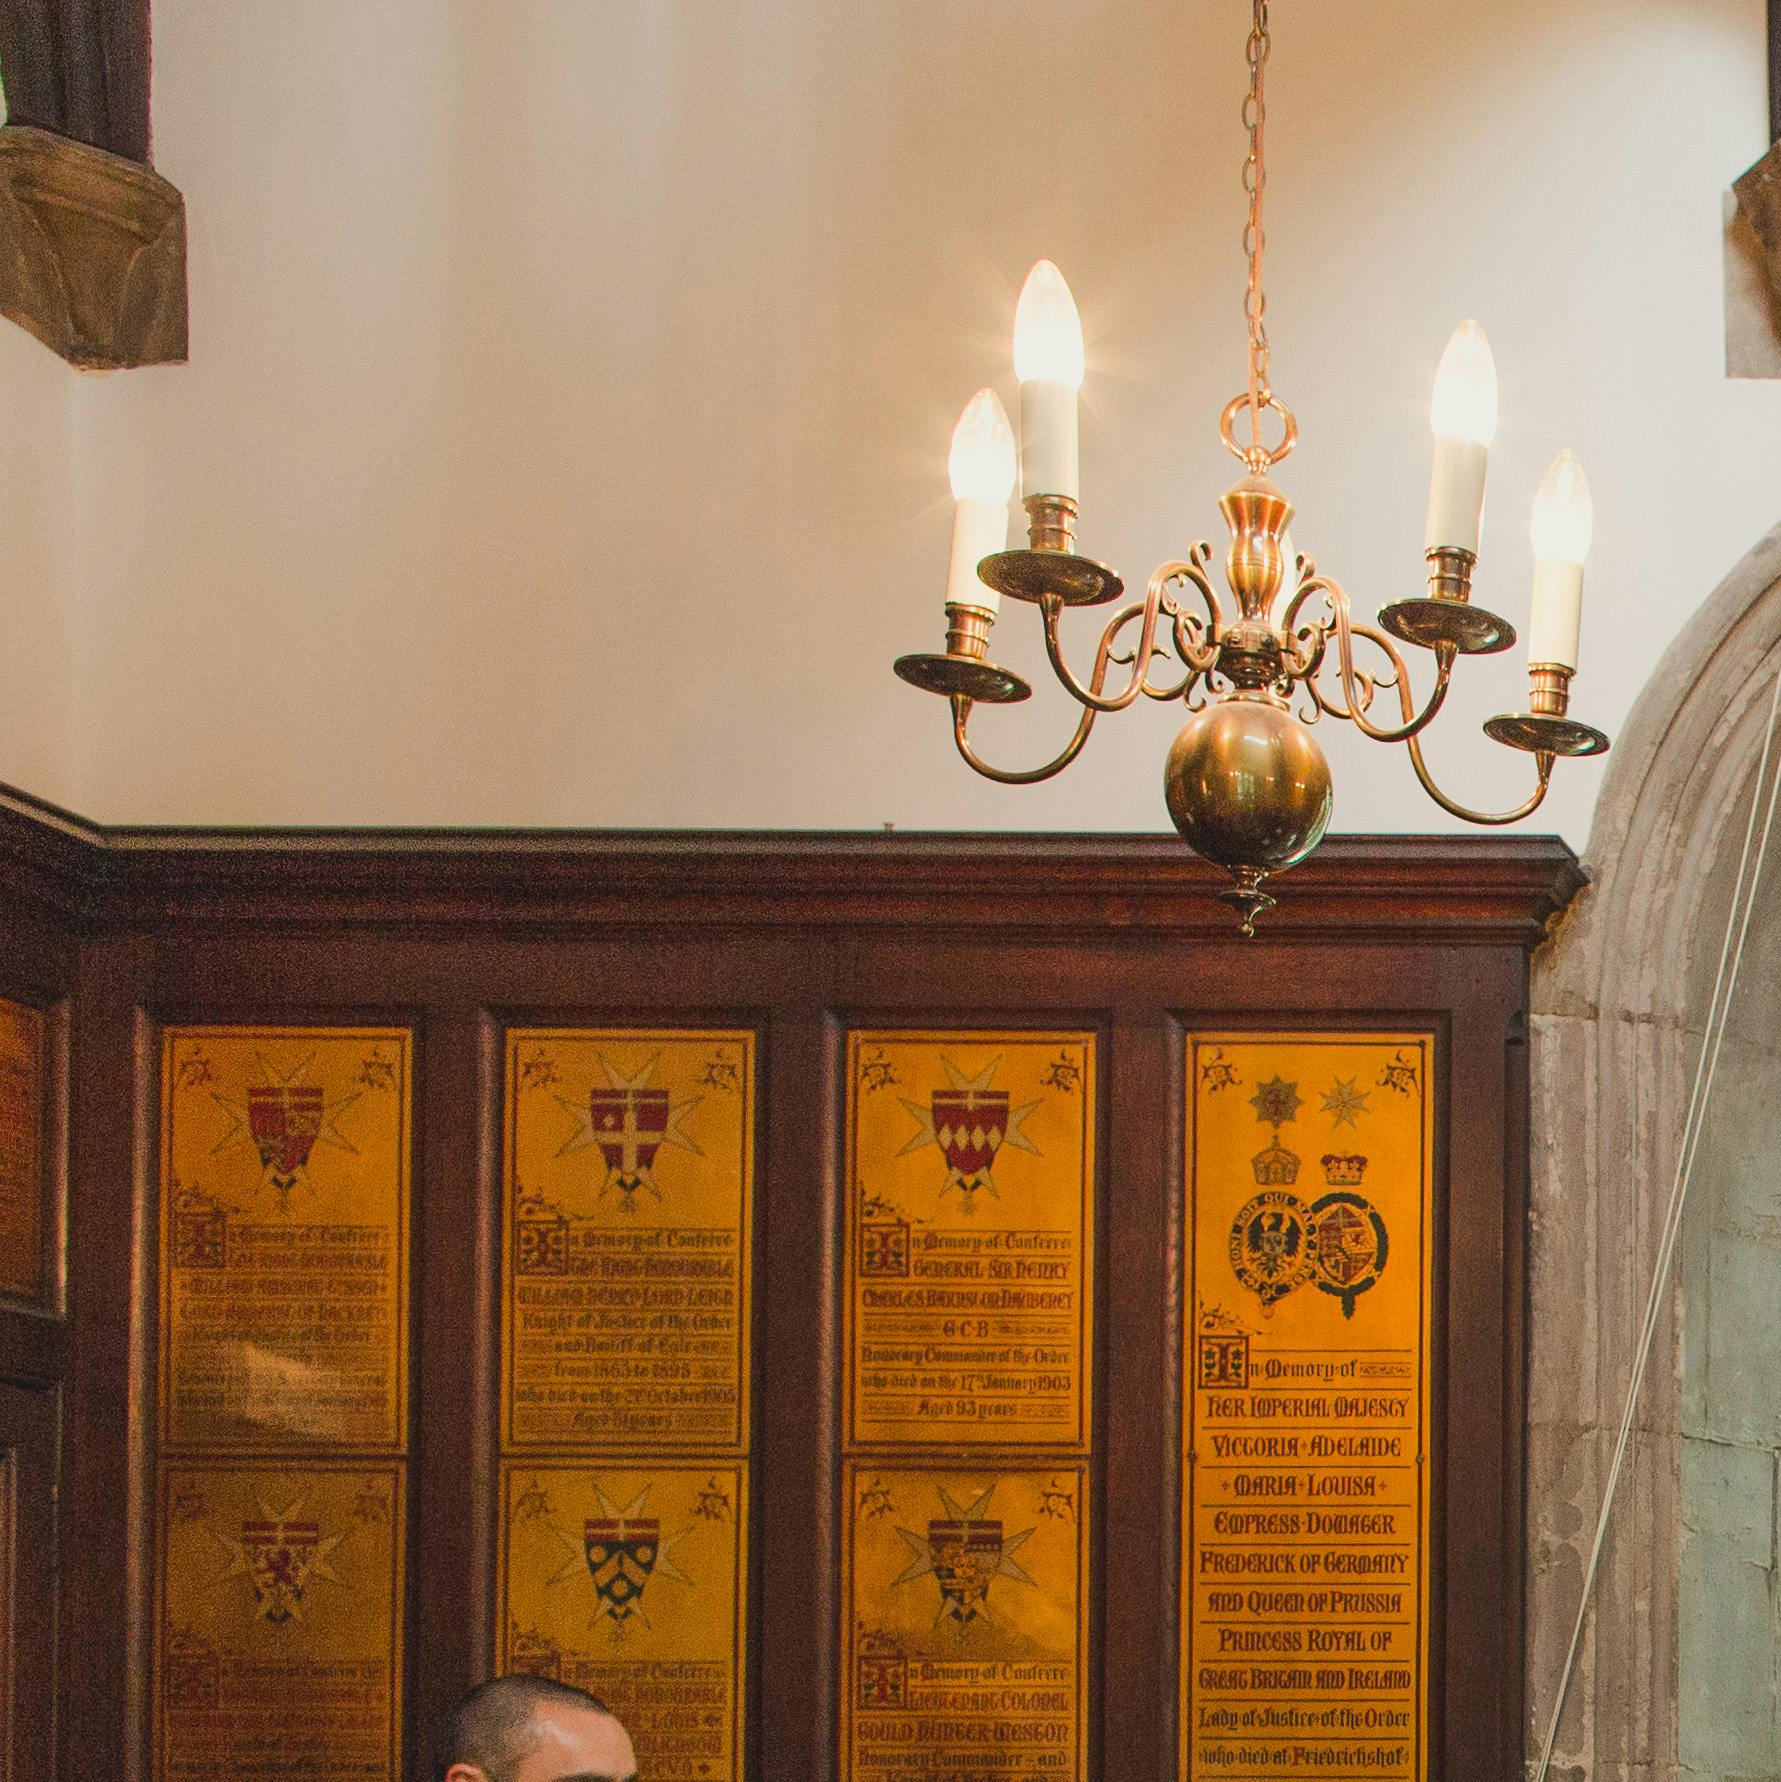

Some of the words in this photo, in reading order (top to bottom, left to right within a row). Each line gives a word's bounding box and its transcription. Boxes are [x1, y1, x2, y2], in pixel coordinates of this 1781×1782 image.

[1265, 1358, 1336, 1383] Memory
[1340, 1359, 1357, 1378] of
[1250, 1395, 1331, 1419] IMPERIAL
[1333, 1395, 1410, 1420] MAJESTY
[1210, 1434, 1300, 1459] VICTORIA
[1308, 1434, 1401, 1458] ADELAIDE
[1233, 1473, 1298, 1498] MARIA
[1307, 1473, 1377, 1497] LOUISA
[1213, 1511, 1301, 1535] EMPRESS
[1306, 1511, 1396, 1535] DOWAGER
[1199, 1550, 1296, 1575] FREDERICK
[1299, 1552, 1321, 1575] OF
[1324, 1551, 1410, 1576] GERMANY
[1207, 1591, 1244, 1614] AND
[1248, 1590, 1305, 1616] QUEEN
[1308, 1592, 1328, 1614] OF
[1329, 1590, 1402, 1614] PRUSSIA
[1217, 1627, 1303, 1653] PRINCESS
[1306, 1627, 1367, 1653] ROYAL
[1370, 1629, 1393, 1652] OF
[1199, 1668, 1249, 1691] GREAT
[1250, 1668, 1313, 1691] BRITAIN
[1315, 1670, 1346, 1691] AND
[1348, 1669, 1412, 1691] IRELAND
[1199, 1706, 1239, 1731] Lady
[1241, 1707, 1257, 1727] of
[1320, 1707, 1338, 1728] of
[1339, 1708, 1362, 1730] the
[1364, 1707, 1411, 1728] Order
